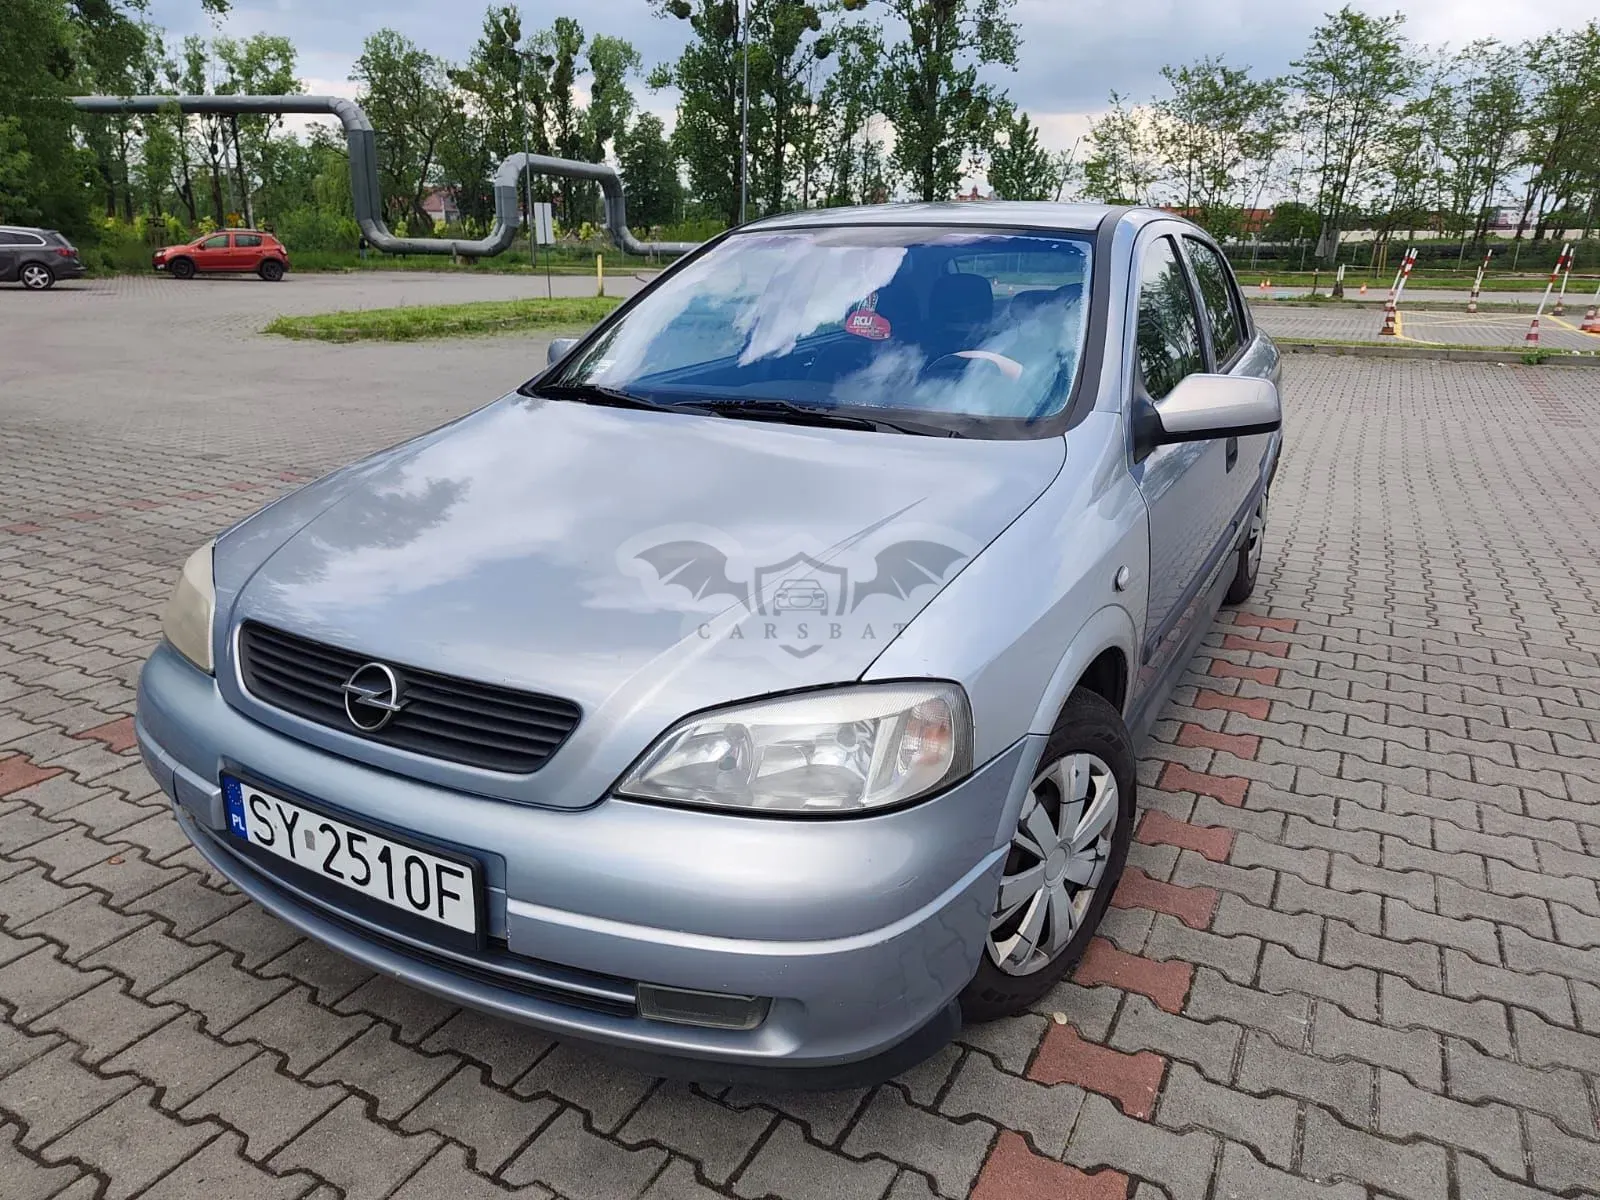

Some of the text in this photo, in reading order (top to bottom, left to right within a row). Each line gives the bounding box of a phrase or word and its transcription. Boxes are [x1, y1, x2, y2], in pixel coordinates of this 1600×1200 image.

[232, 813, 245, 832] PL
[249, 793, 464, 919] SY 2510F
